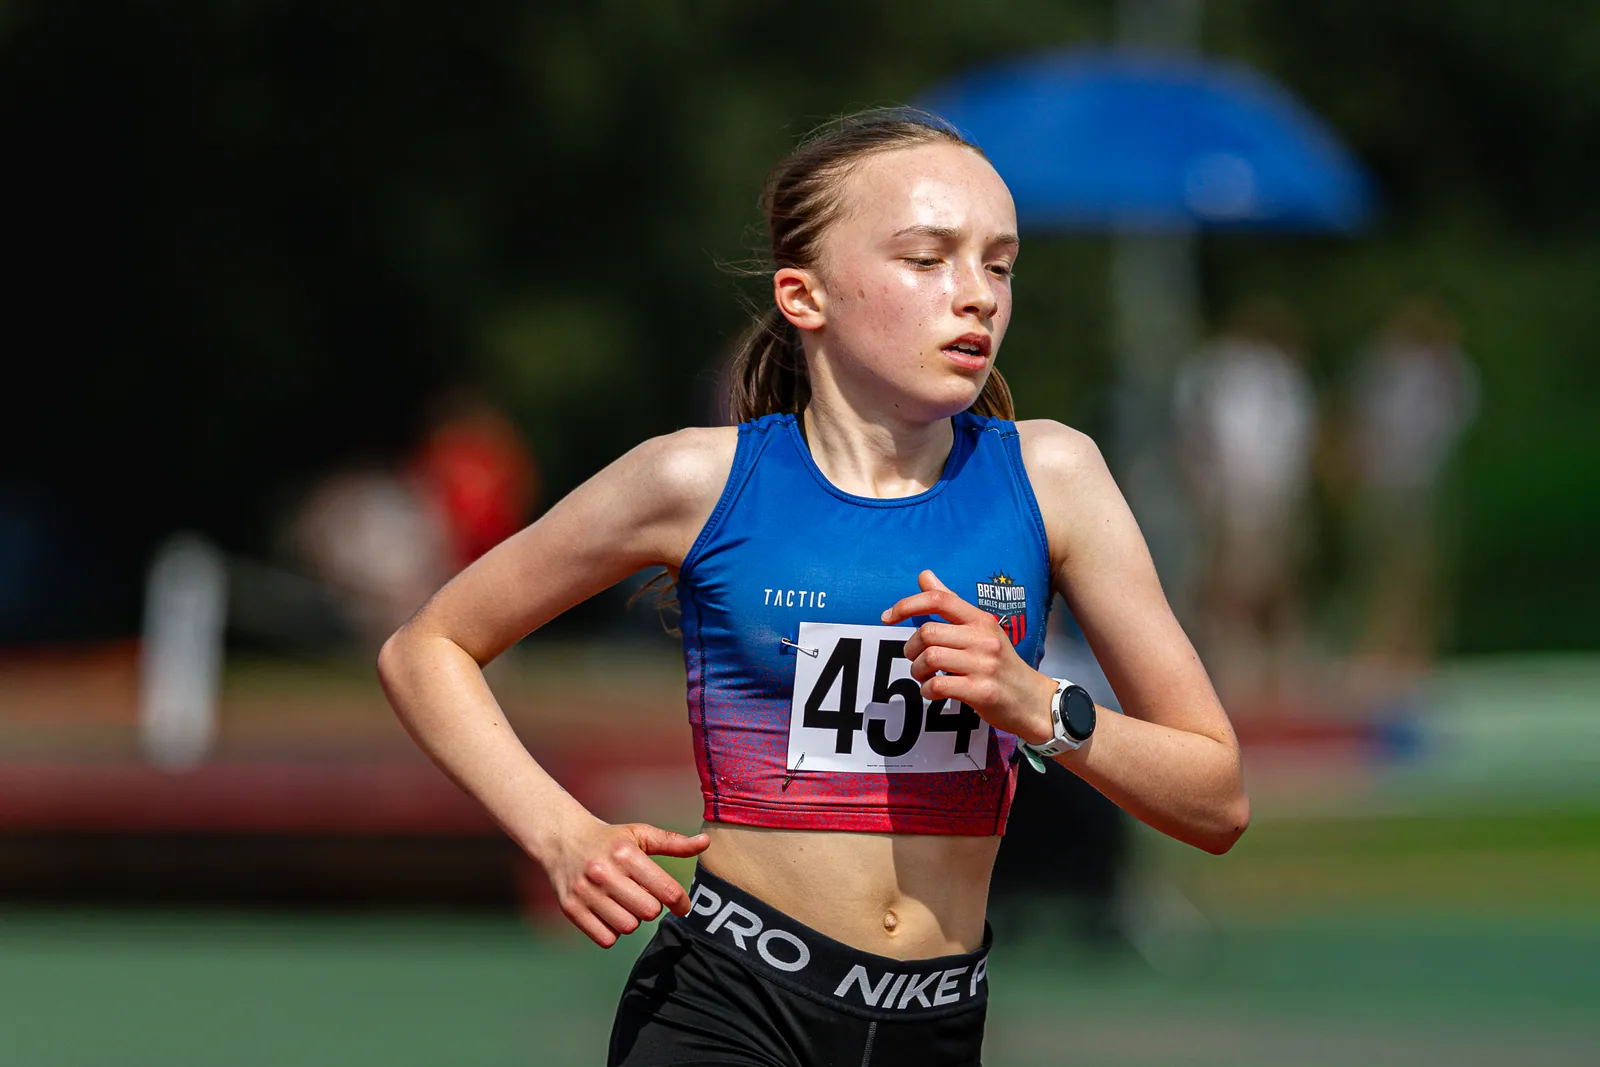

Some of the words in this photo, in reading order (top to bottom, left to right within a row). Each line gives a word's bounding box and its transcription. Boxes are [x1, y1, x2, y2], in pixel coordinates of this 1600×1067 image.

[764, 588, 827, 609] TACTIC
[977, 583, 1025, 601] BRENTWOOD
[978, 598, 998, 608] BEAGLES
[998, 601, 1018, 610] ATHLETICS
[1017, 601, 1026, 609] CLUB
[685, 883, 811, 972] PRO
[834, 964, 970, 1009] NIKE
